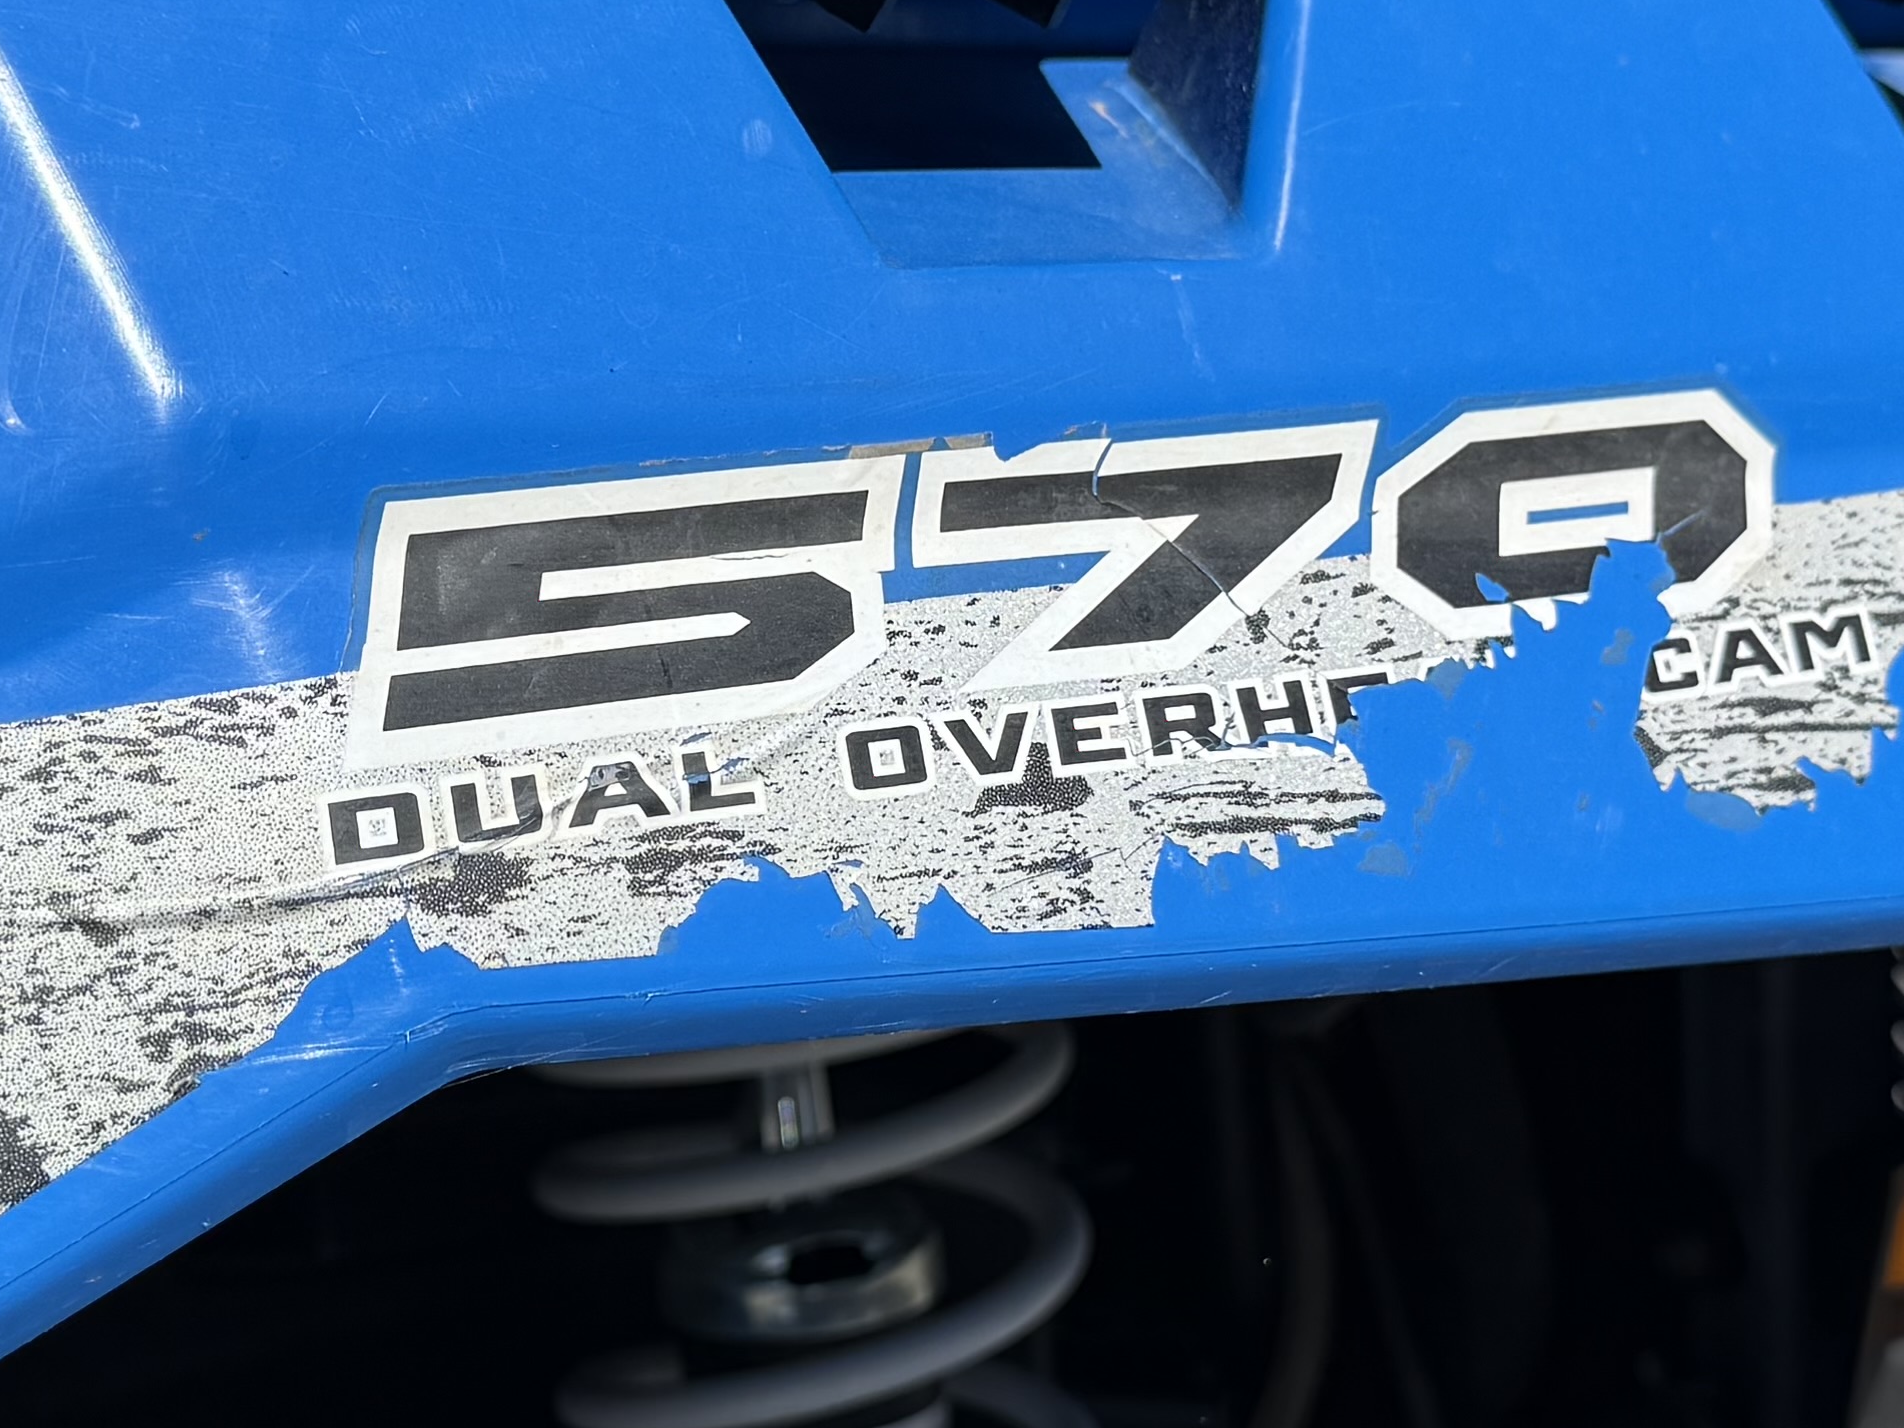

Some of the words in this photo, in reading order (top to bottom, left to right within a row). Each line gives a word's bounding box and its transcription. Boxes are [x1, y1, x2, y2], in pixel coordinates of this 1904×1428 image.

[381, 415, 1750, 734] 570
[326, 750, 758, 866] DUAL
[1643, 612, 1872, 694] CAM
